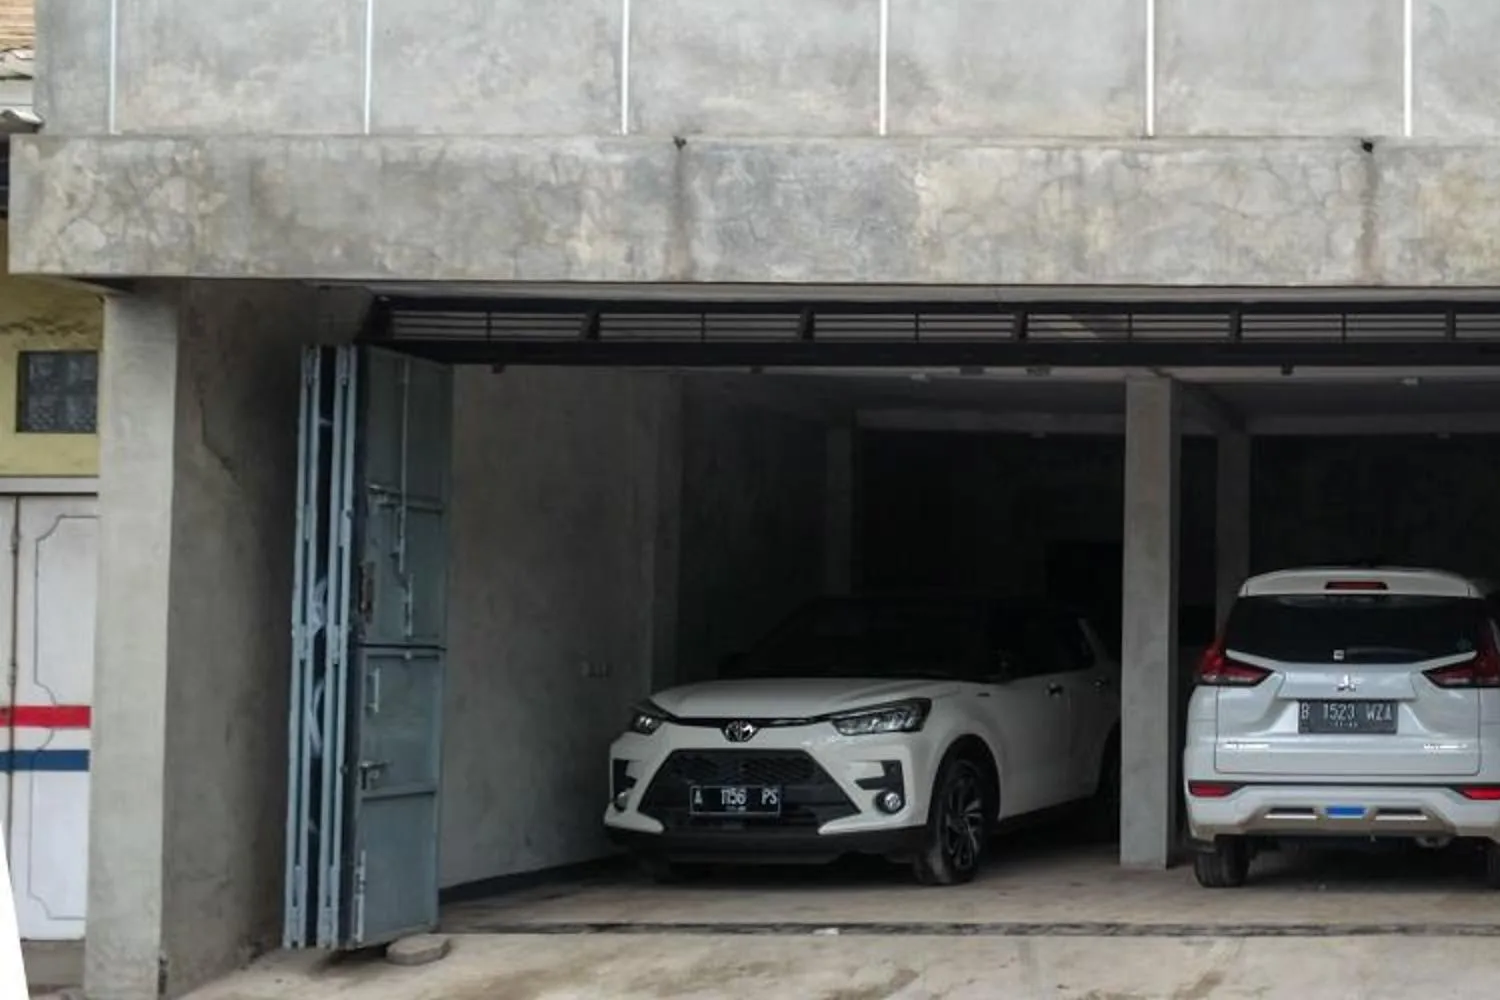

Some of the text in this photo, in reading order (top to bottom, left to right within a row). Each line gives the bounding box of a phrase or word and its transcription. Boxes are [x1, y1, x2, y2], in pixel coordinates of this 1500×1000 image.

[1301, 702, 1393, 721] B 1523 WZA
[694, 789, 703, 805] A
[761, 787, 778, 805] PS
